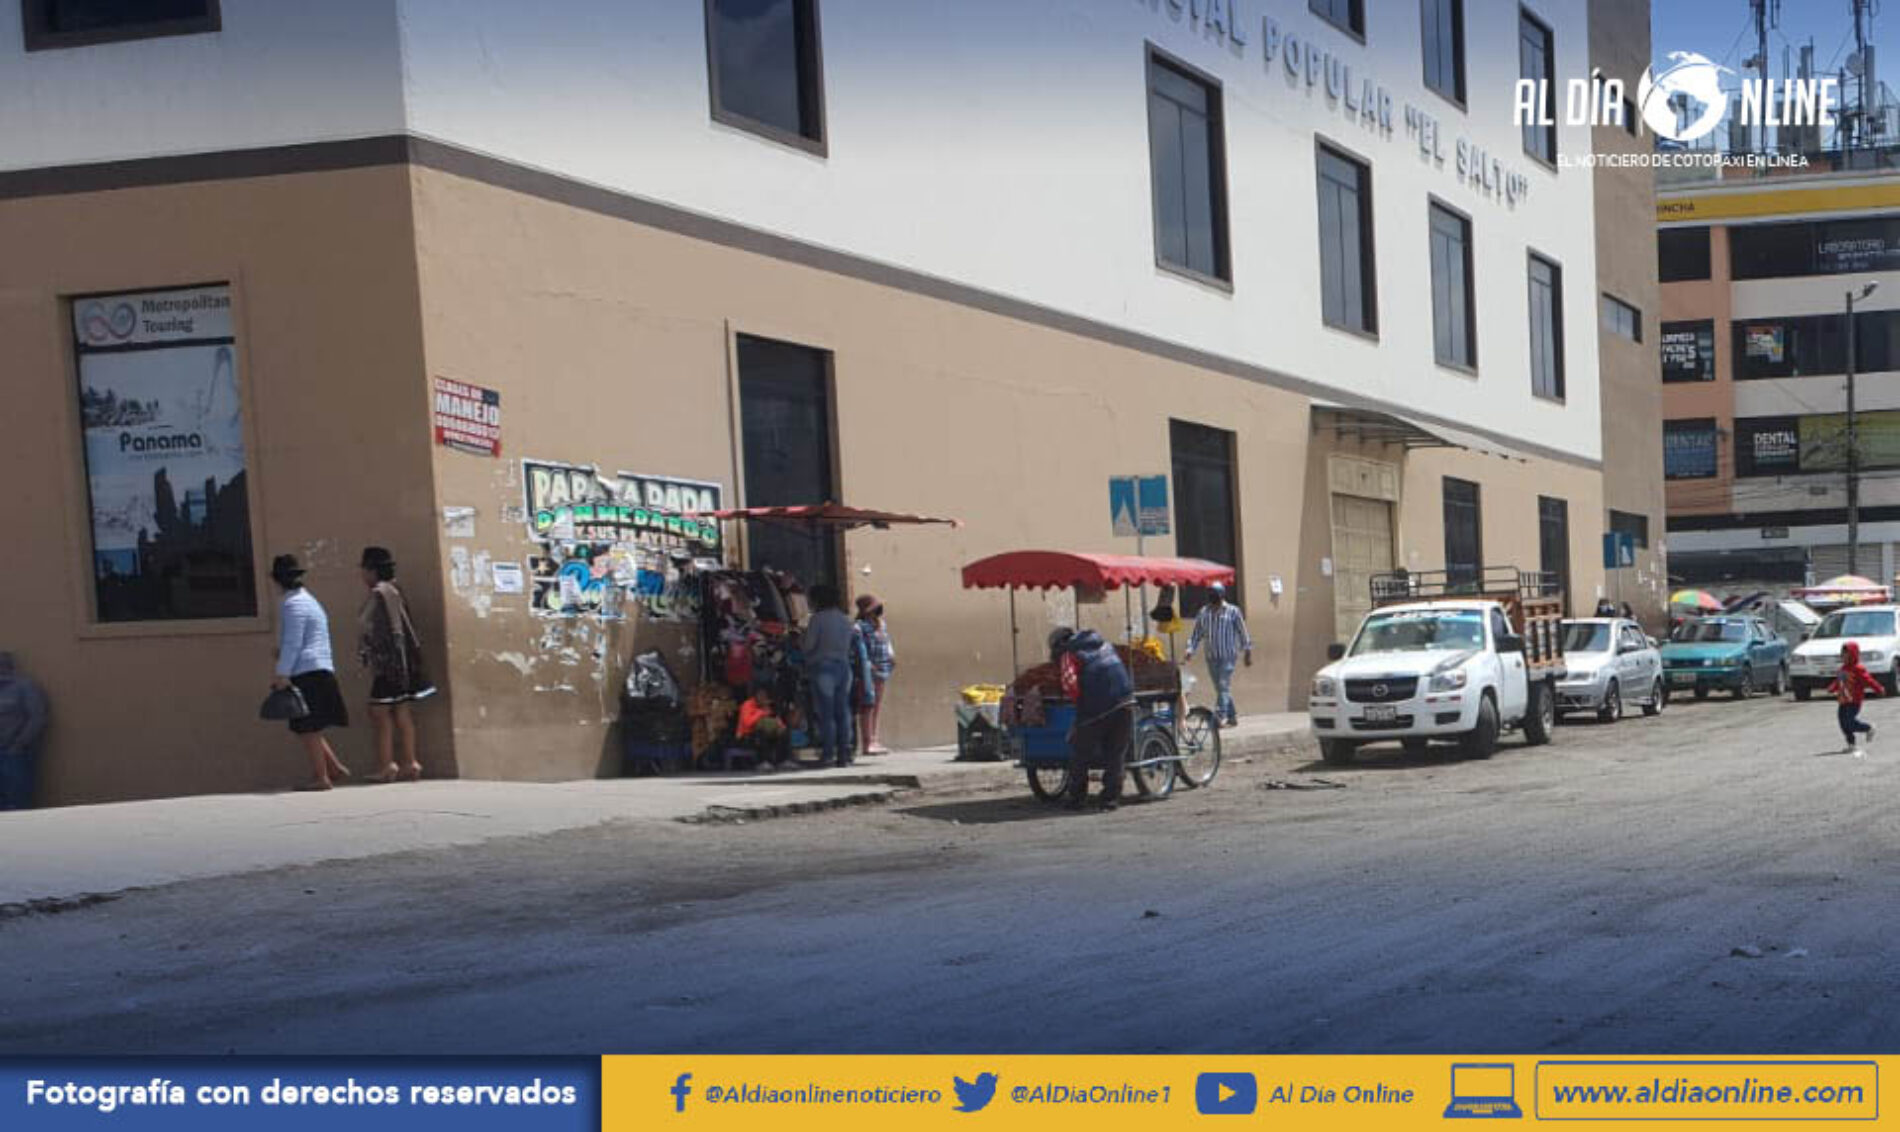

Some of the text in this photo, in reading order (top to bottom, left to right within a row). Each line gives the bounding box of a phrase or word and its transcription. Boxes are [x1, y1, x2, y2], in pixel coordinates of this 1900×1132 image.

[1261, 14, 1396, 134] POPULAR
[142, 295, 231, 313] Metropolitan
[142, 318, 194, 333] Touring
[435, 392, 500, 427] MANEJO
[119, 432, 202, 452] Panama
[1753, 430, 1797, 445] DENTAL
[645, 481, 715, 516] DADA
